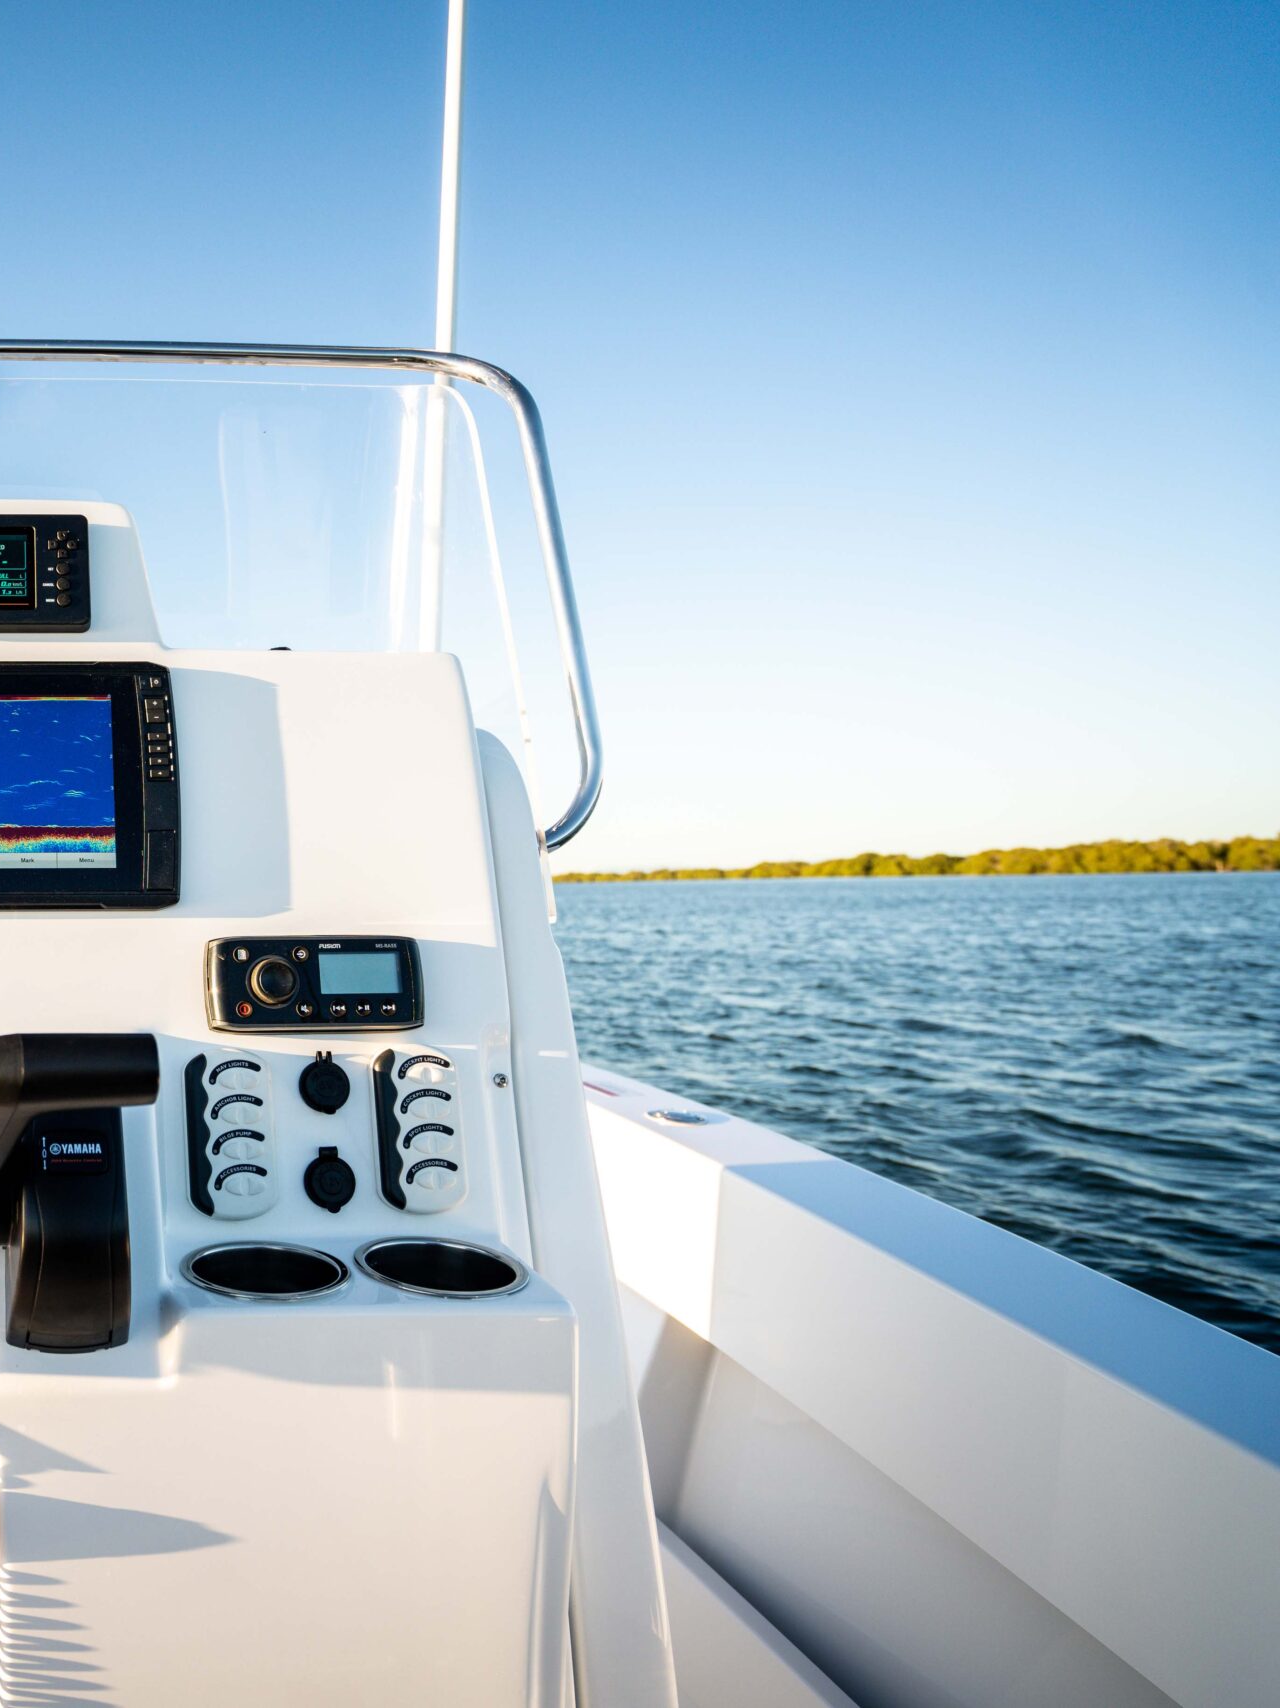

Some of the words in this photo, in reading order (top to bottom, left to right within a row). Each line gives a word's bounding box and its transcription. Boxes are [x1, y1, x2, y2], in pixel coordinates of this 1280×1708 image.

[402, 1057, 423, 1071] COCKPIT
[215, 1097, 236, 1111] ANCHOR
[404, 1092, 424, 1106] COCKPIT
[219, 1132, 234, 1142] BILGE
[409, 1128, 421, 1137] SPOT
[61, 1144, 102, 1154] YAMAHA
[220, 1166, 256, 1179] ACCESSORIES
[412, 1161, 447, 1173] ACCESSORIES
